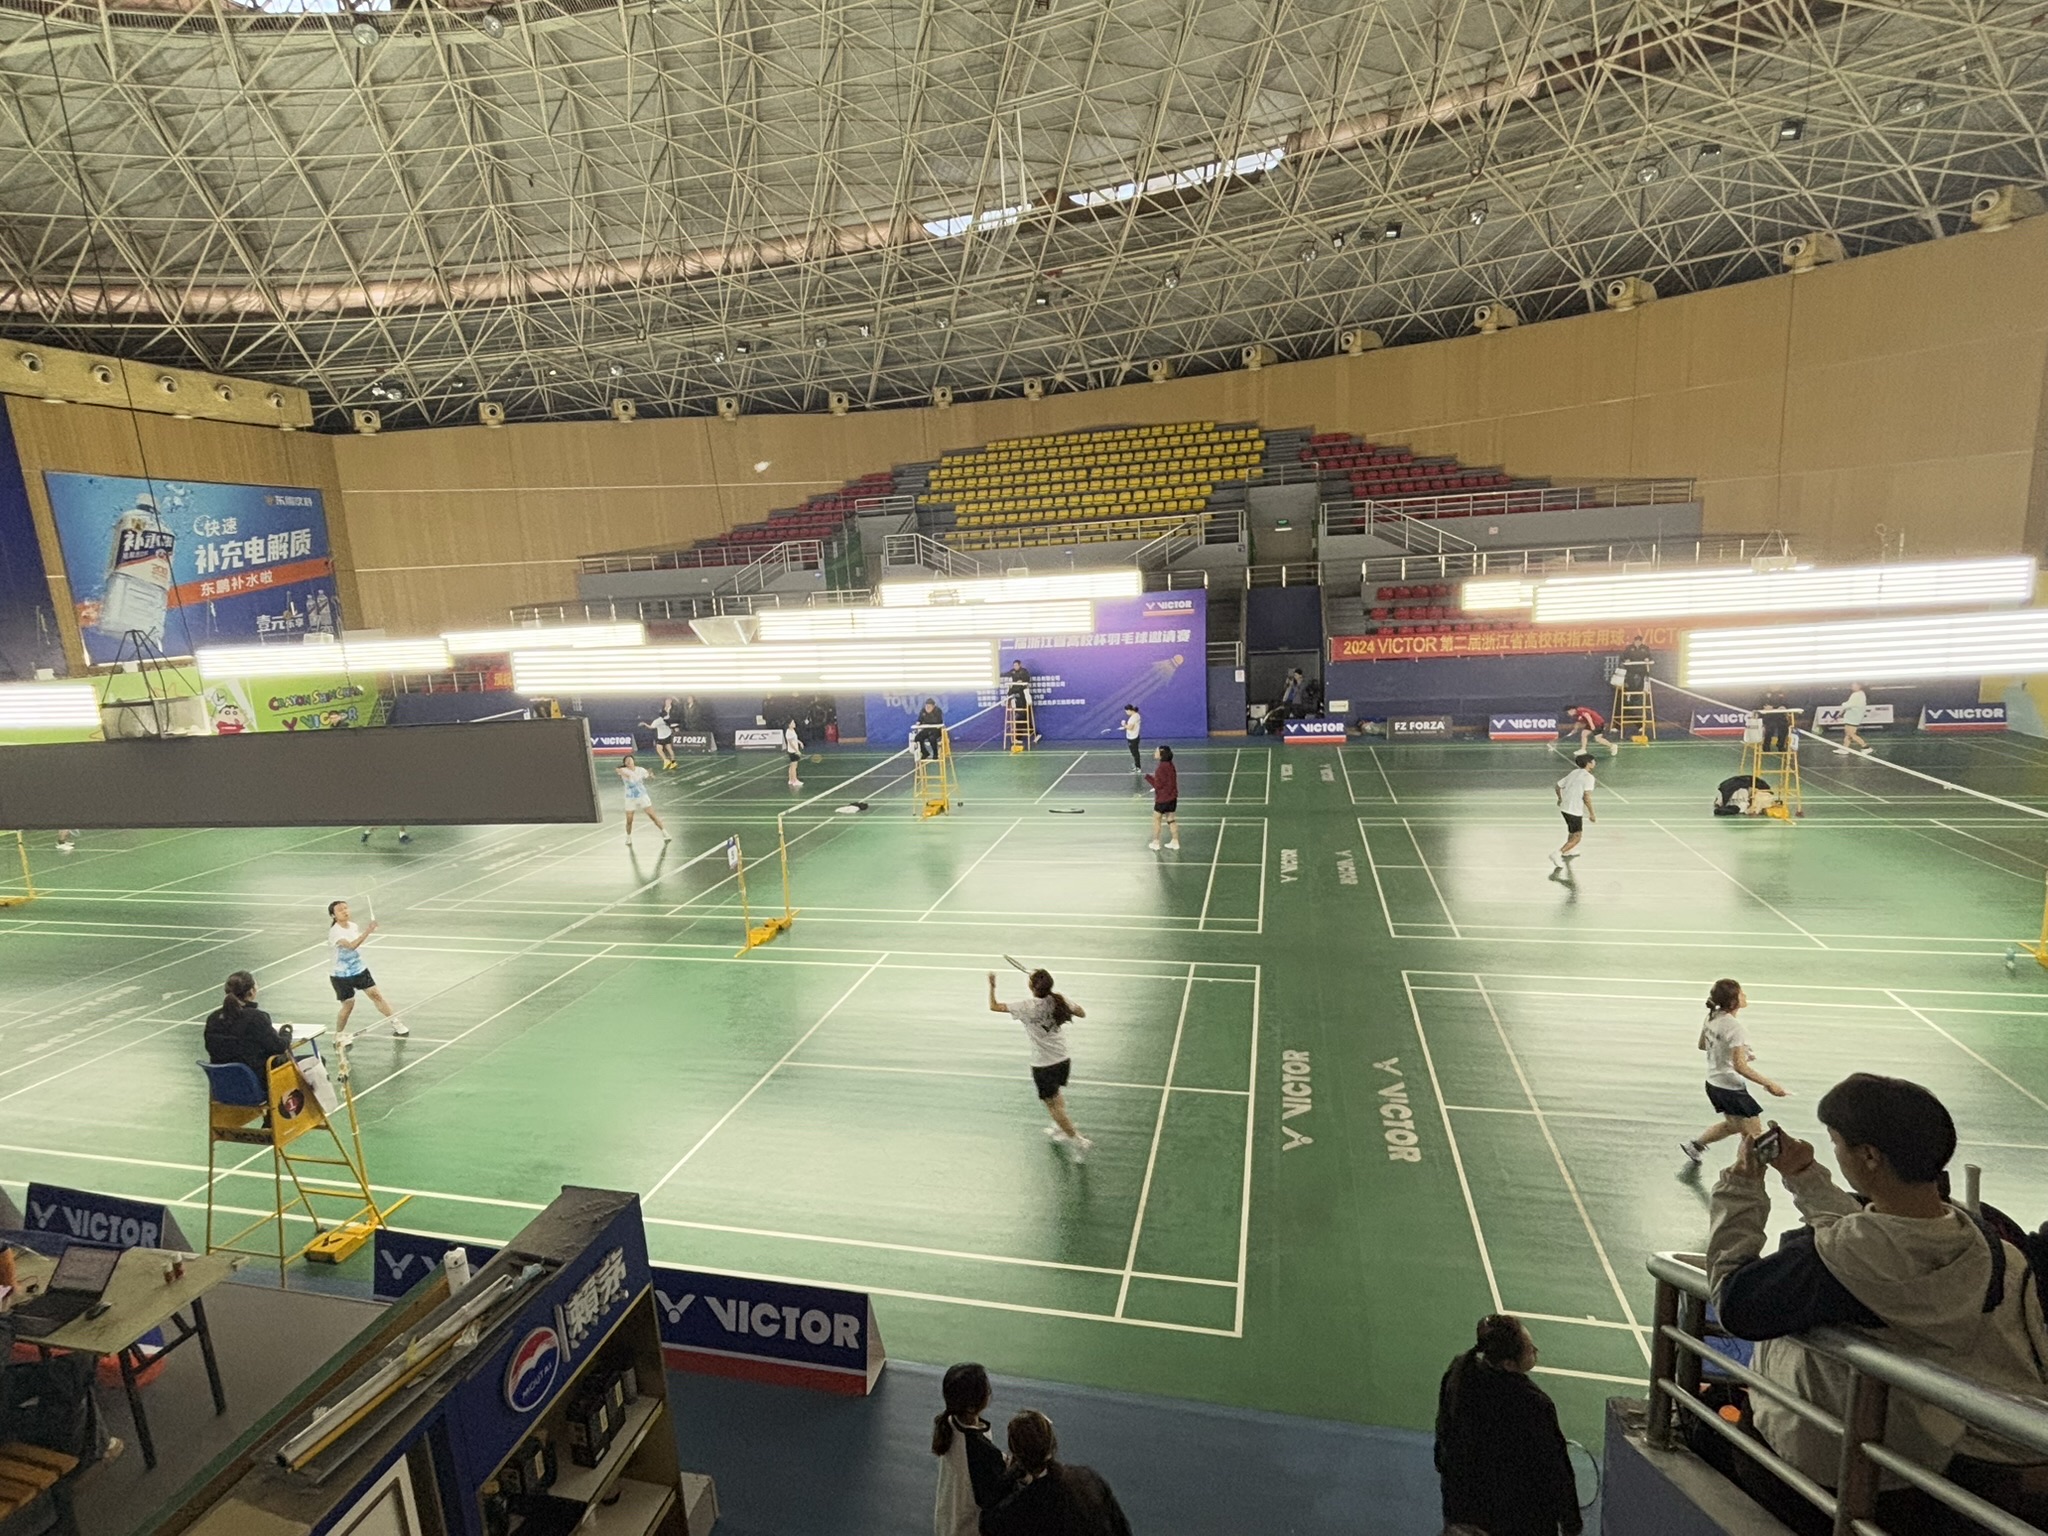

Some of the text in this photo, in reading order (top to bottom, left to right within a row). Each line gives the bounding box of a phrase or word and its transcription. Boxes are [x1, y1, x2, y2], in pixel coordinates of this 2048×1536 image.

[204, 517, 238, 537] 快速
[194, 528, 313, 575] 补充电解质
[200, 570, 274, 597] 东鹏补水啦
[1157, 600, 1193, 610] VICTOR
[999, 629, 1192, 650] 二届浙江省高校杯羽毛球邀请赛
[1343, 639, 1375, 656] 2024
[1377, 636, 1438, 655] VICTOR
[268, 693, 311, 711] CRAYON
[1945, 707, 2005, 719] VICTOR
[1301, 722, 1344, 733] VICTOR
[1394, 720, 1445, 731] FZ FORZA
[1508, 718, 1557, 729] VICTOR
[601, 736, 632, 746] VICTOR
[683, 736, 707, 744] FORZA
[738, 732, 770, 741] NCS
[1282, 1049, 1311, 1121] VICTOR
[1378, 1082, 1421, 1163] VICTOR
[62, 1205, 159, 1249] VICTOR
[704, 1295, 860, 1350] VICTOR
[522, 1362, 553, 1399] MOUTAI
